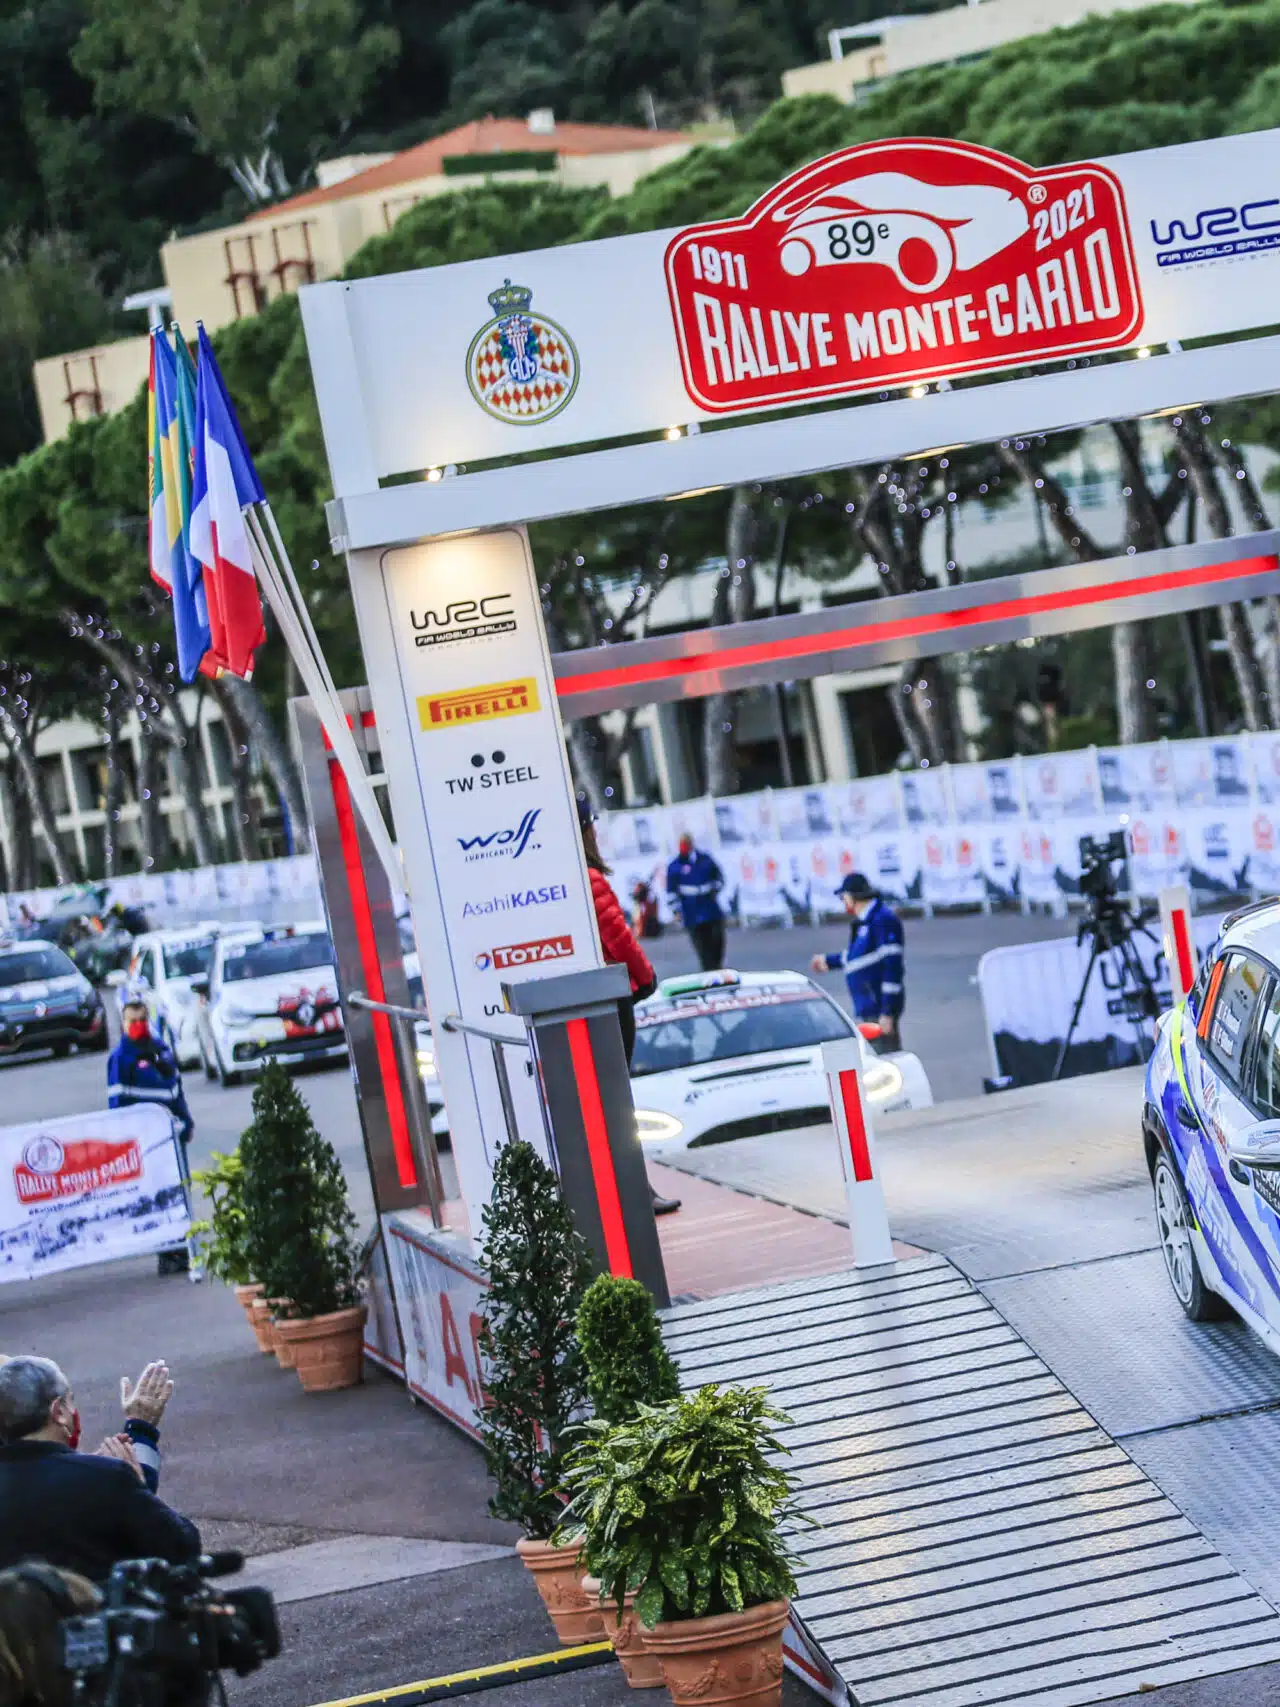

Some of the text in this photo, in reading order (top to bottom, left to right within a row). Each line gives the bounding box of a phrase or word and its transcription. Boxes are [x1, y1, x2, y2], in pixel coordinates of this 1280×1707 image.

[1034, 181, 1095, 252] 2021
[688, 243, 748, 290] 1911
[1183, 244, 1234, 260] WORLD
[693, 228, 1120, 386] RALLYE MONTE-CARLO
[410, 594, 514, 630] WRC
[428, 685, 528, 723] PIRELLI
[445, 766, 539, 795] TW STEEL
[465, 848, 514, 863] LUBRICANTS
[462, 884, 567, 919] AsahiKASEI
[495, 941, 571, 966] TOTAL
